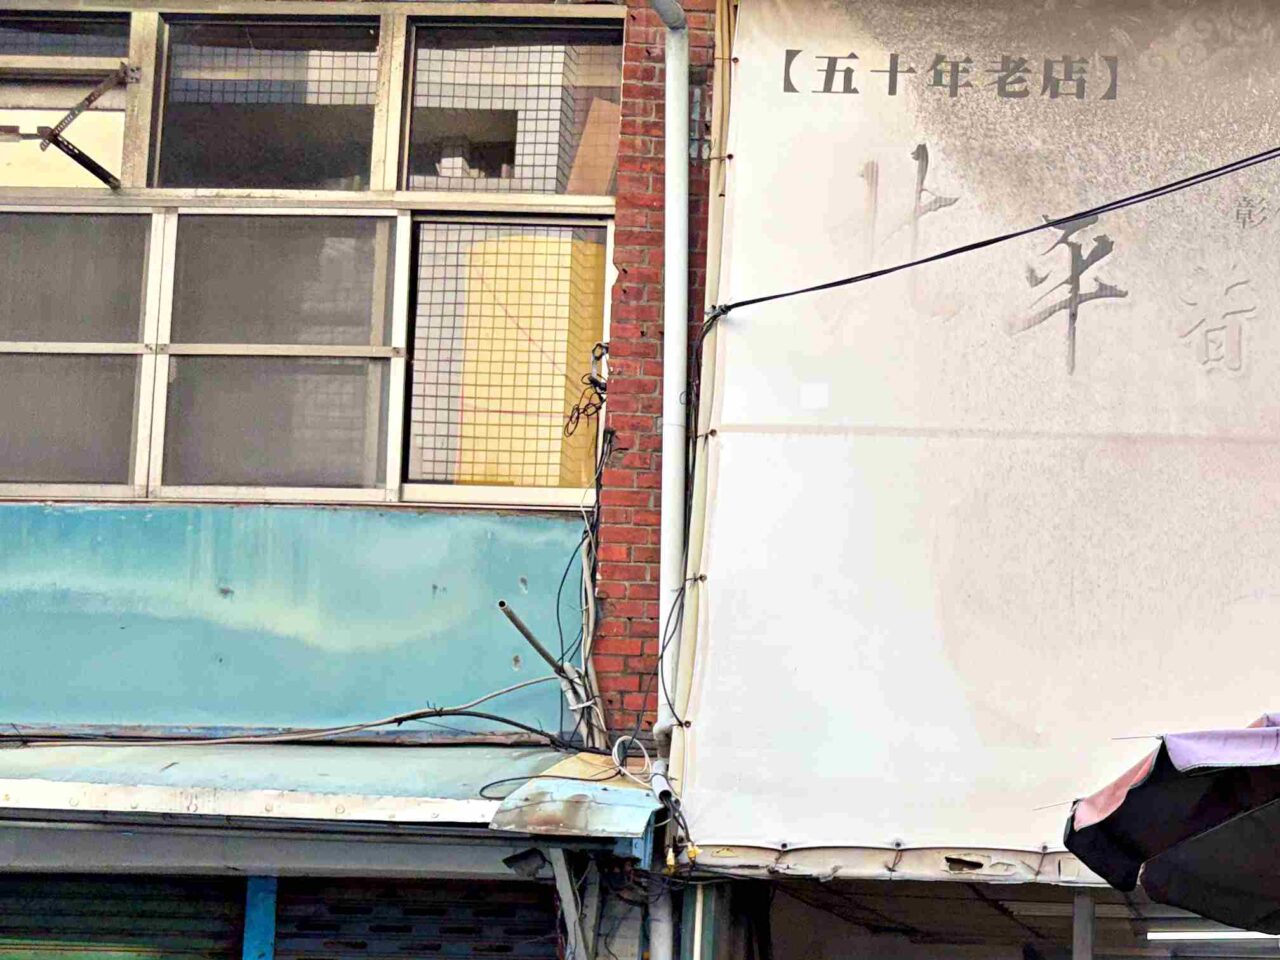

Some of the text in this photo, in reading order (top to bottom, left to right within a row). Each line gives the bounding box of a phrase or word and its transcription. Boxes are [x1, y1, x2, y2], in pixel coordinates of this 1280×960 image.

[783, 49, 1118, 100] 【五十年老店】
